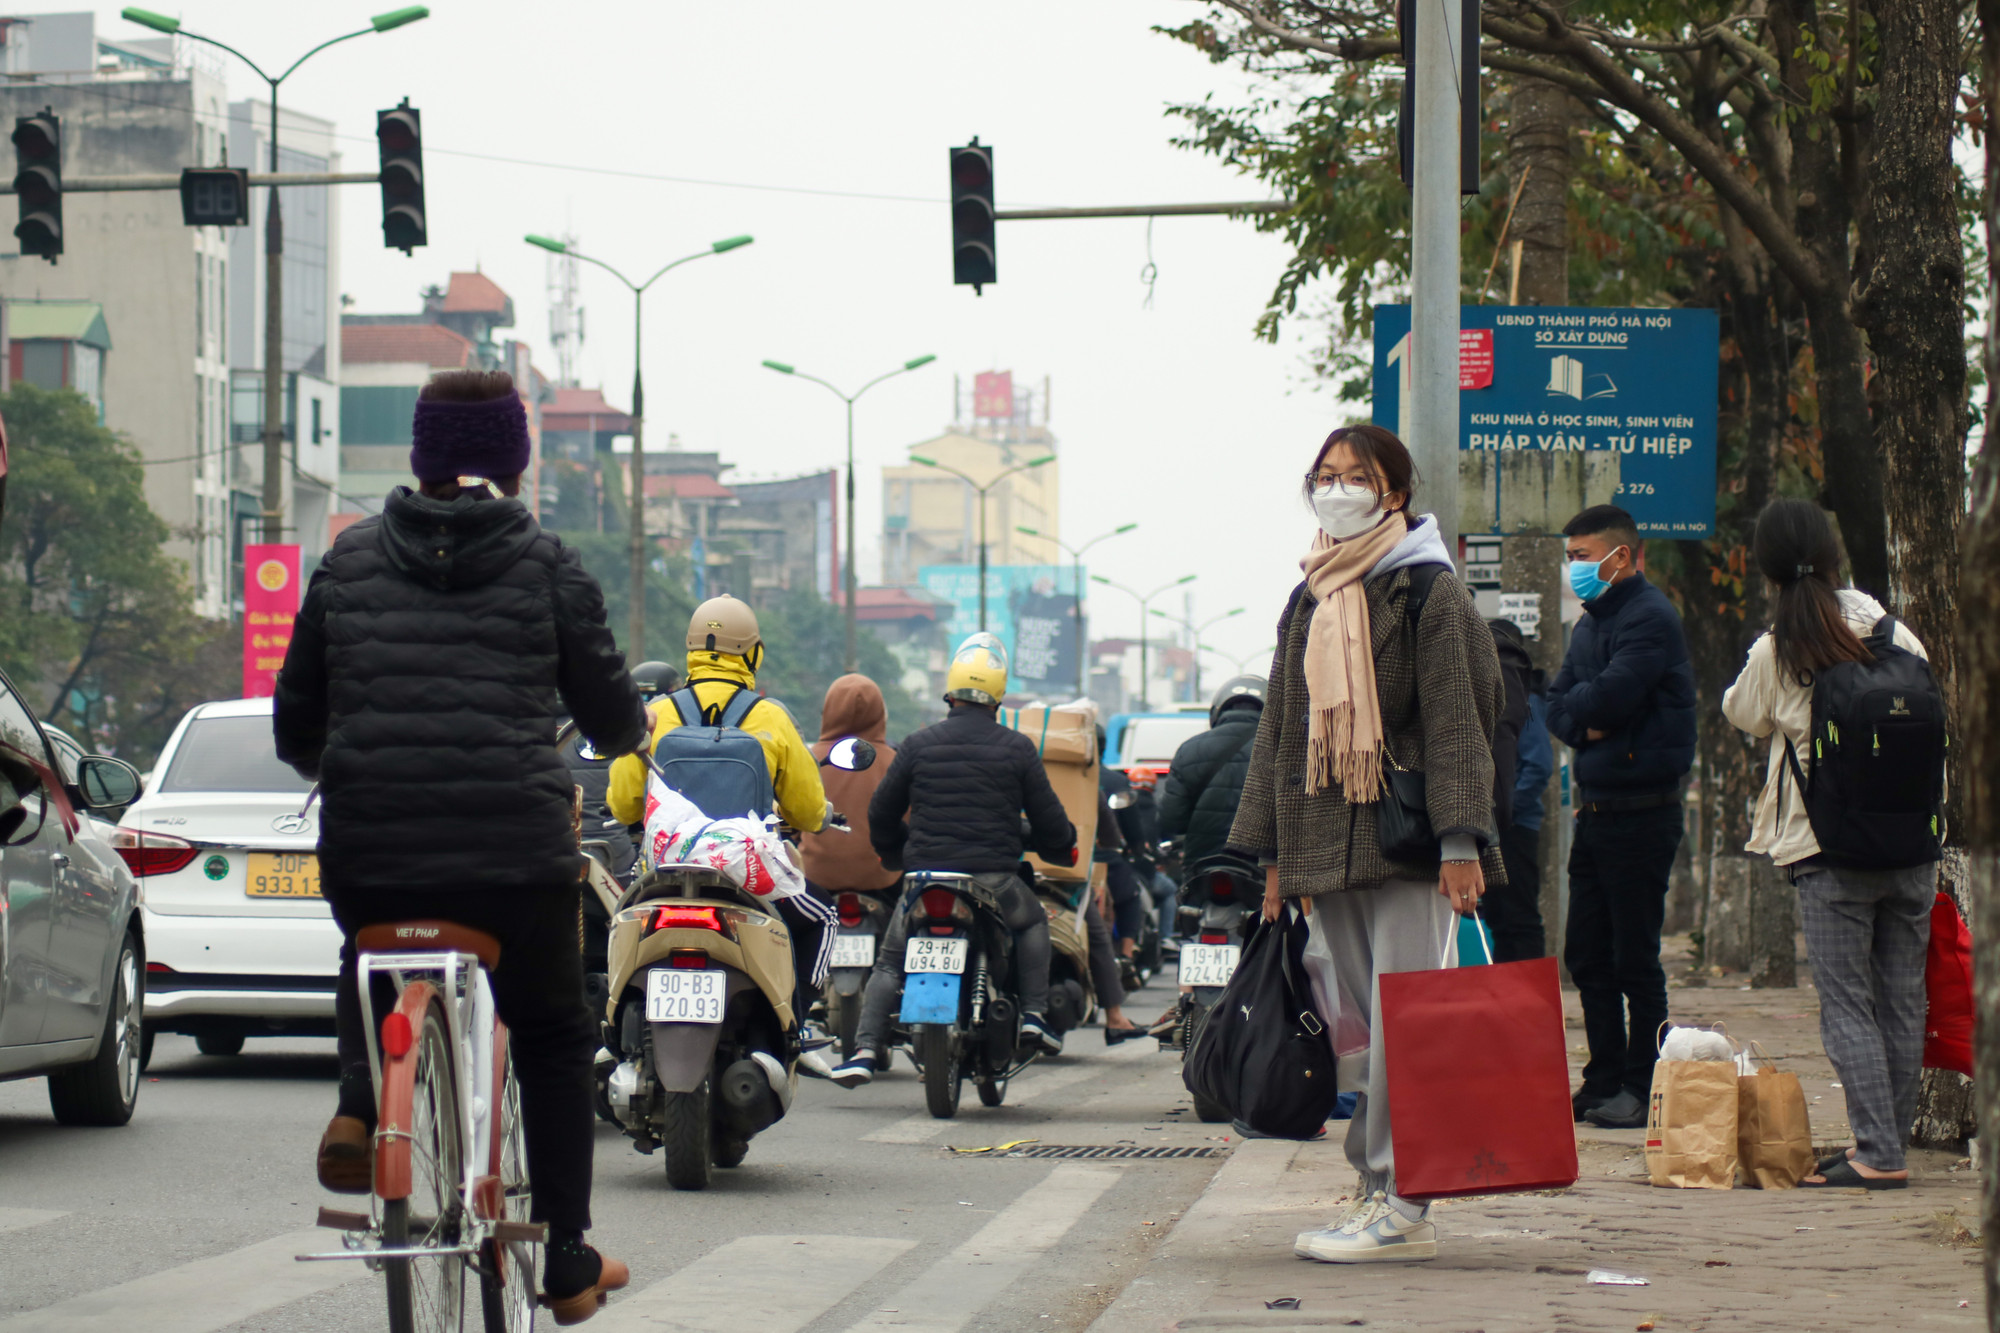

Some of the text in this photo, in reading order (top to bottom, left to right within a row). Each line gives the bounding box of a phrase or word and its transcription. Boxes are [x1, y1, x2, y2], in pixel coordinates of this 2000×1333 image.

[1496, 311, 1671, 331] UBND THÀNH PHỐ HÀ NỘI
[1557, 329, 1585, 342] XÂY
[1588, 332, 1629, 346] DỰNG
[1471, 410, 1694, 429] KHU NHÀ Ở HỌC SINH, SINH VIÊN
[1469, 429, 1531, 450] PHÁP
[1536, 430, 1586, 451] VÂN
[1607, 430, 1637, 454] TỨ
[1642, 432, 1692, 459] HIỆP
[1629, 483, 1655, 495] 276
[1673, 521, 1687, 531] HÀ
[1689, 521, 1707, 532] NỘI
[272, 855, 310, 873] 30F
[396, 928, 440, 939] VIET PHAP
[917, 940, 957, 954] 29-H2
[660, 974, 713, 995] 90-B3
[654, 997, 719, 1019] 120.93
